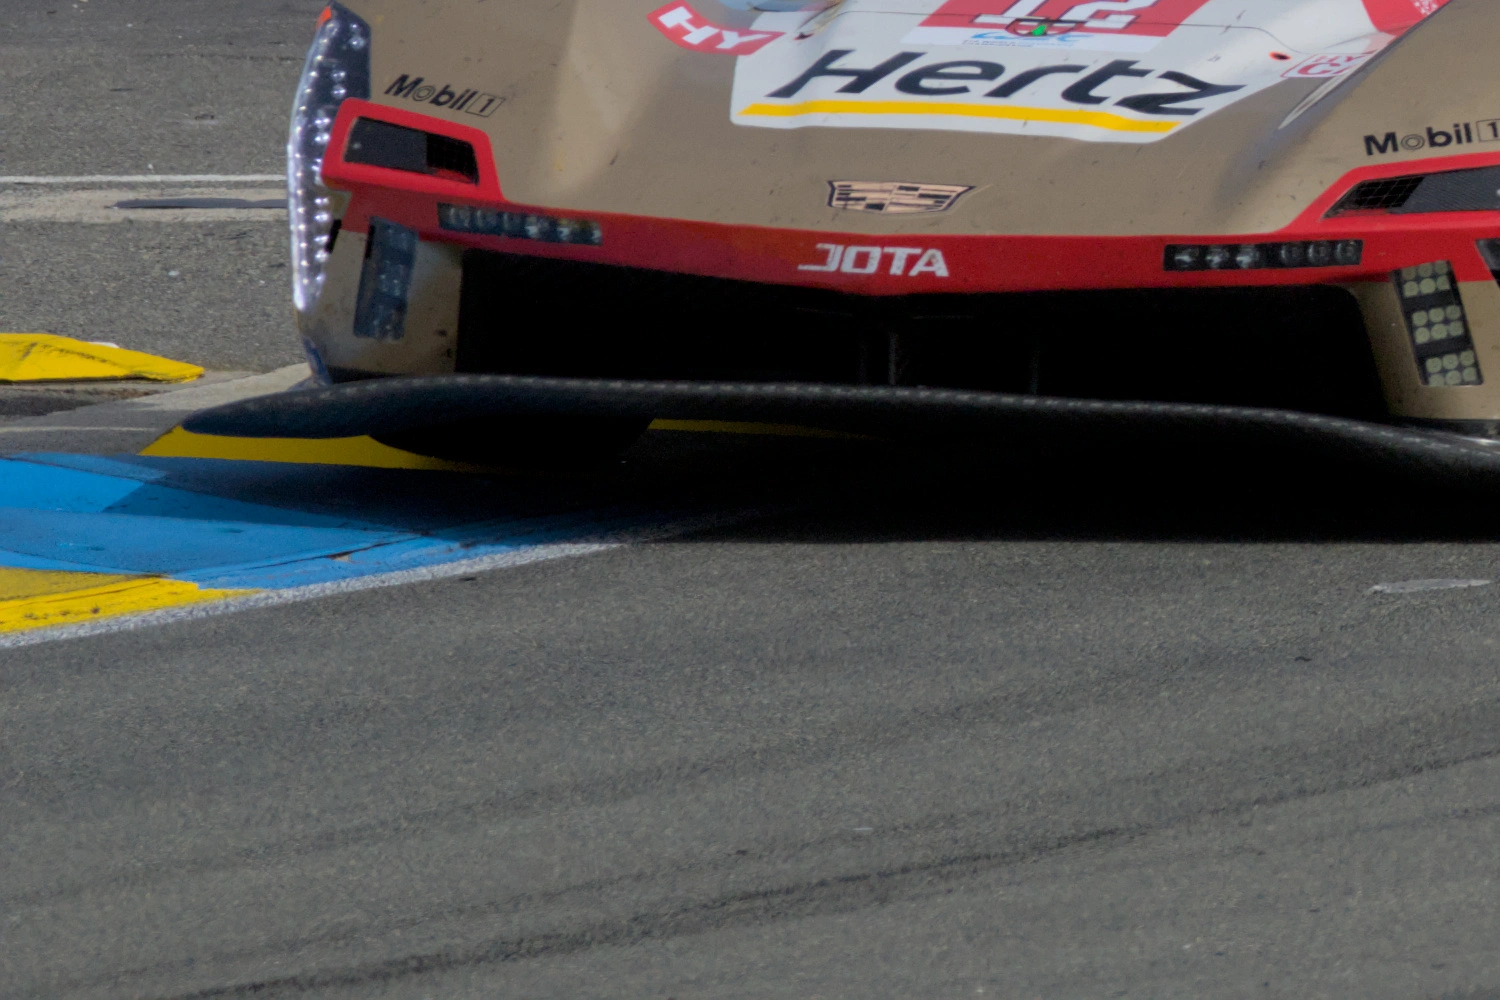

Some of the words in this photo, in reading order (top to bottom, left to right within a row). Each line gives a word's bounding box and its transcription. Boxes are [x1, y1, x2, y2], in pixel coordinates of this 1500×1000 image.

[657, 6, 773, 50] HY
[384, 73, 480, 111] Mobil
[764, 48, 1248, 116] Hertz
[1363, 122, 1472, 156] Mobil
[797, 243, 949, 277] JOTA
